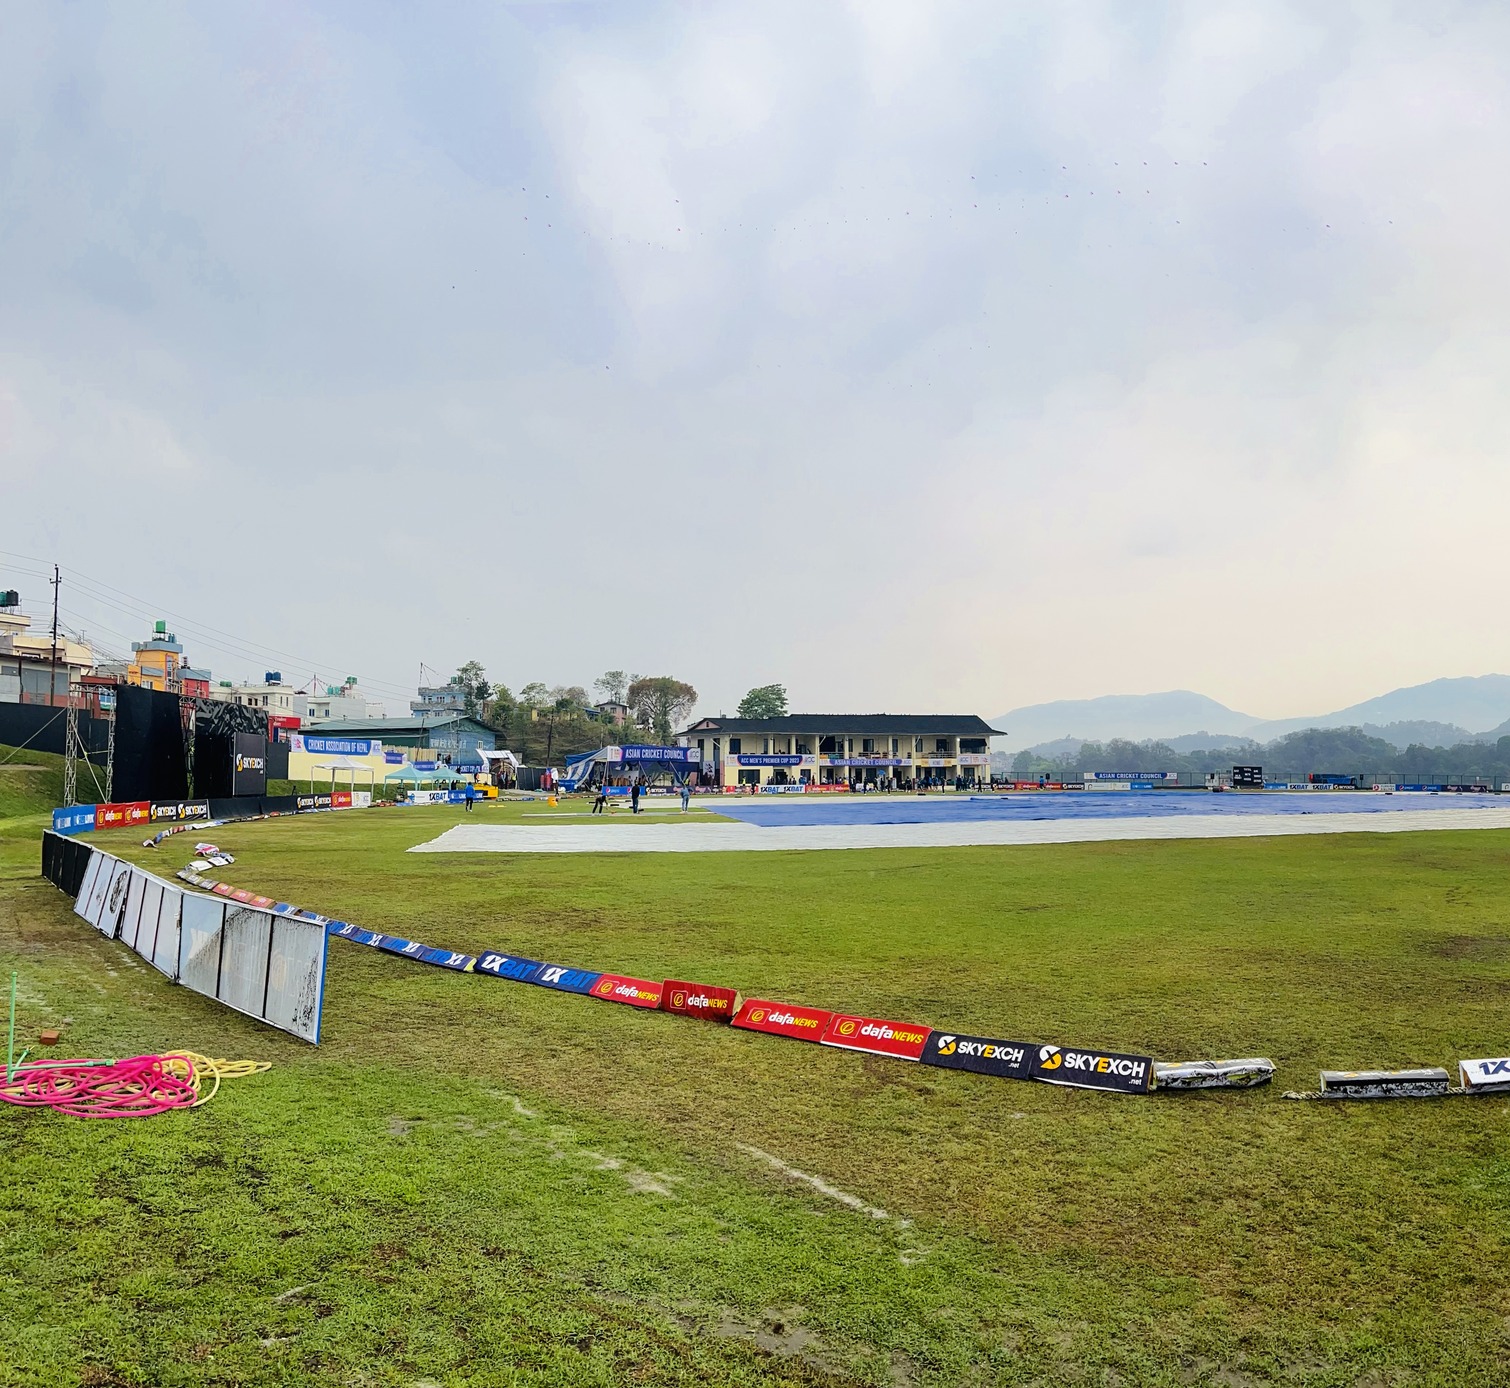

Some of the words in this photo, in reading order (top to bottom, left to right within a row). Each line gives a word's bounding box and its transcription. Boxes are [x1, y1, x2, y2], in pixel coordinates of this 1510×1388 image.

[308, 739, 325, 750] CRICKET
[325, 740, 351, 752] ASSOCIATION
[351, 742, 356, 752] OF
[356, 742, 368, 753] NEPAL
[625, 749, 640, 759] ASIAN
[642, 749, 663, 759] CRICKET
[664, 749, 684, 759] COUNCIL
[429, 792, 447, 800] 1XBAT
[483, 954, 538, 980] 1XBAT
[541, 966, 599, 988] 1XBAT
[615, 984, 658, 1001] dafaNEWS
[687, 995, 728, 1010] dafaNEWS
[768, 1011, 819, 1028] dafaNEWS
[861, 1023, 924, 1044] dafaNEWS
[957, 1041, 1024, 1062] SKYEXCH
[1008, 1061, 1020, 1069] .net
[1064, 1051, 1145, 1078] SKYEXCH
[1128, 1078, 1142, 1086] .net
